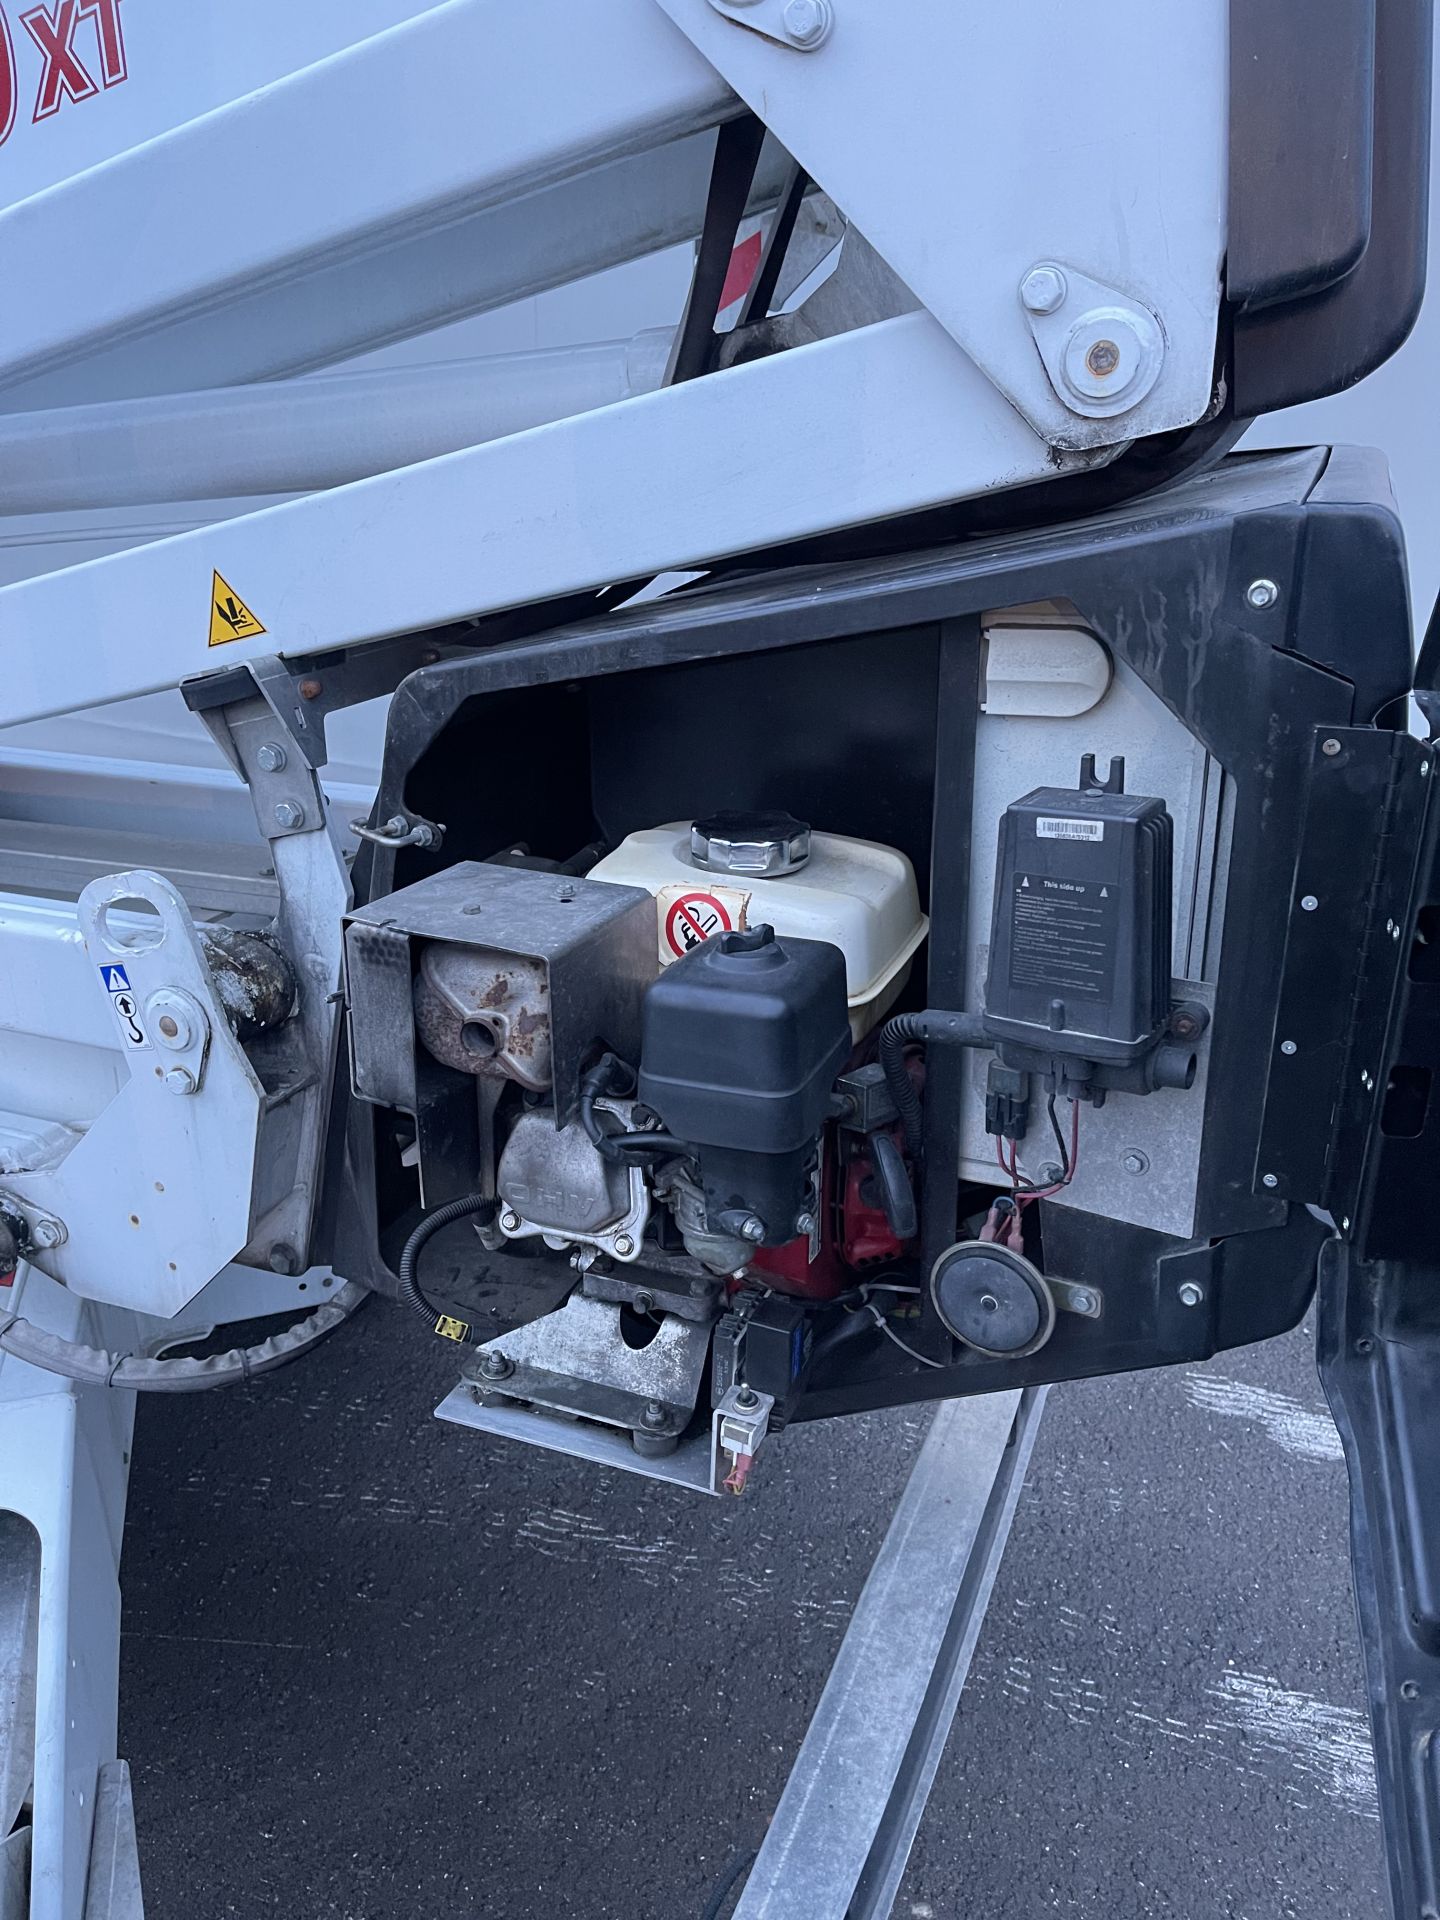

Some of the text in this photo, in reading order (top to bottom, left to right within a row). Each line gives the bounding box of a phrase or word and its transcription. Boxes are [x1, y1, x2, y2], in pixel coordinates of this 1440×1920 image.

[1043, 880, 1058, 889] This
[1059, 883, 1074, 891] side
[505, 1182, 595, 1218] OHV
